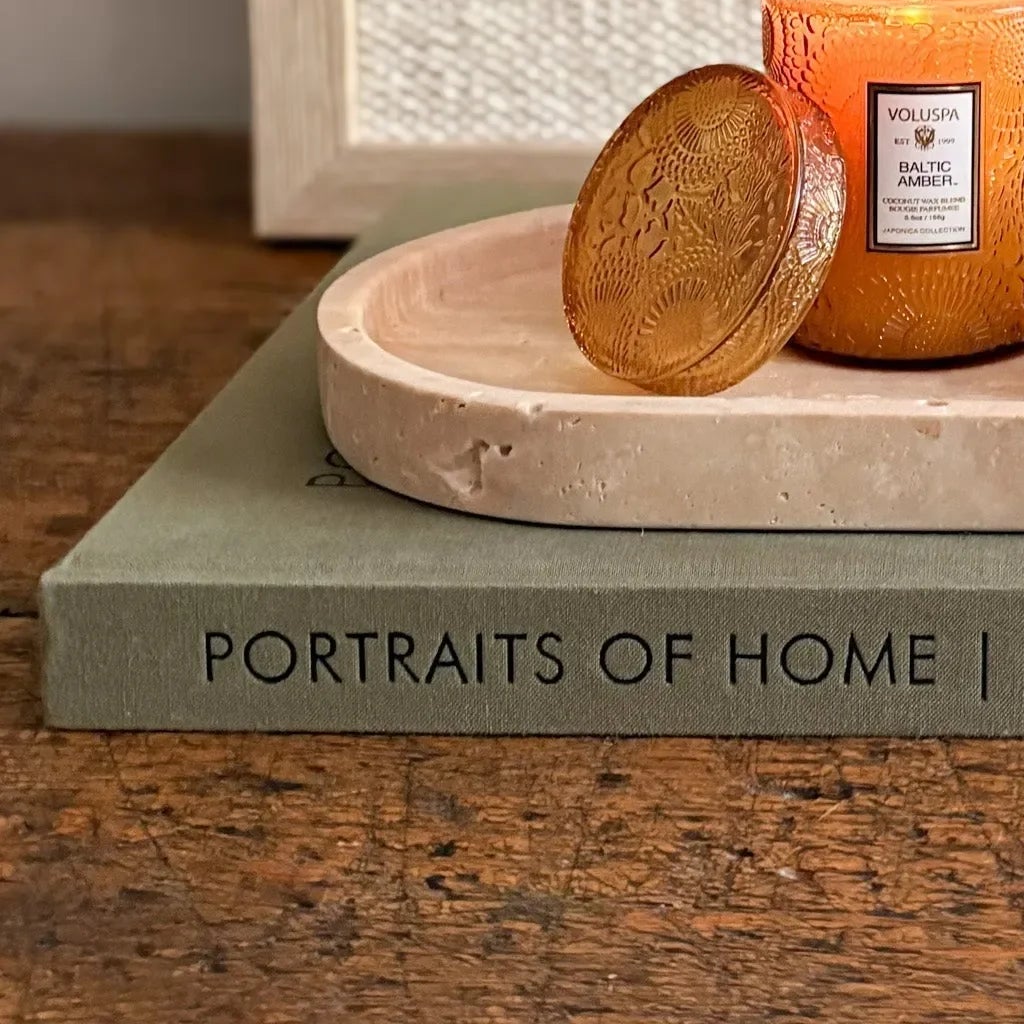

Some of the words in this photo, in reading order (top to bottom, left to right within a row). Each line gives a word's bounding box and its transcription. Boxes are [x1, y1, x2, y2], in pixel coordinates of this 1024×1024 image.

[888, 108, 960, 122] VOLUSPA
[899, 161, 952, 174] BALTIC
[205, 631, 564, 684] PORTRAITS
[600, 633, 693, 684] OF
[729, 633, 937, 686] HOME
